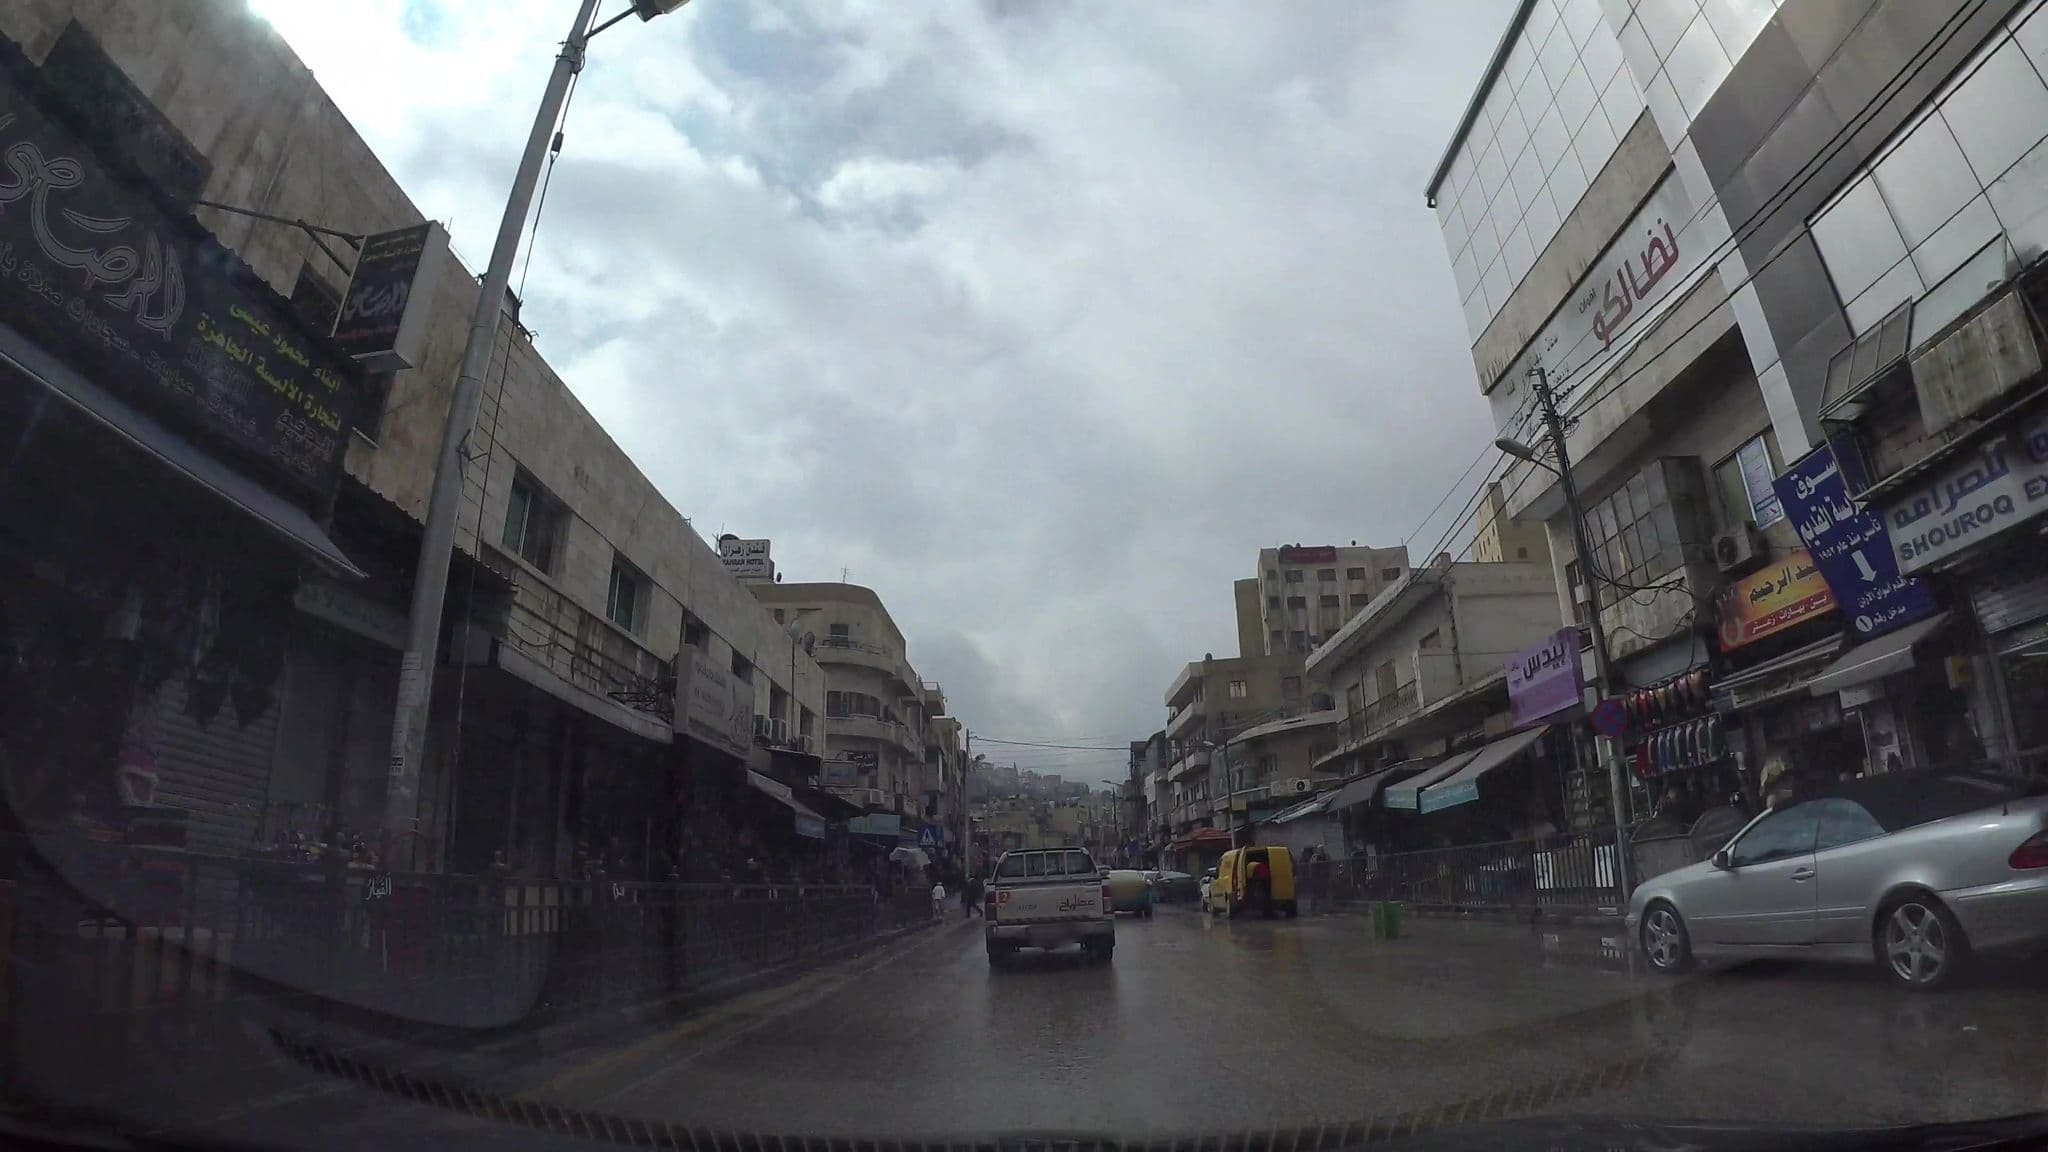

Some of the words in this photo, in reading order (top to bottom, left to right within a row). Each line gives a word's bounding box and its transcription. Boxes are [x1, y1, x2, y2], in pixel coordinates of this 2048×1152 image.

[1790, 460, 1839, 500] سوق
[1799, 503, 1835, 549] القديم
[1898, 494, 2016, 561] SHOUROQ
[746, 541, 765, 556] فندق
[1749, 565, 1792, 608] الرحيم
